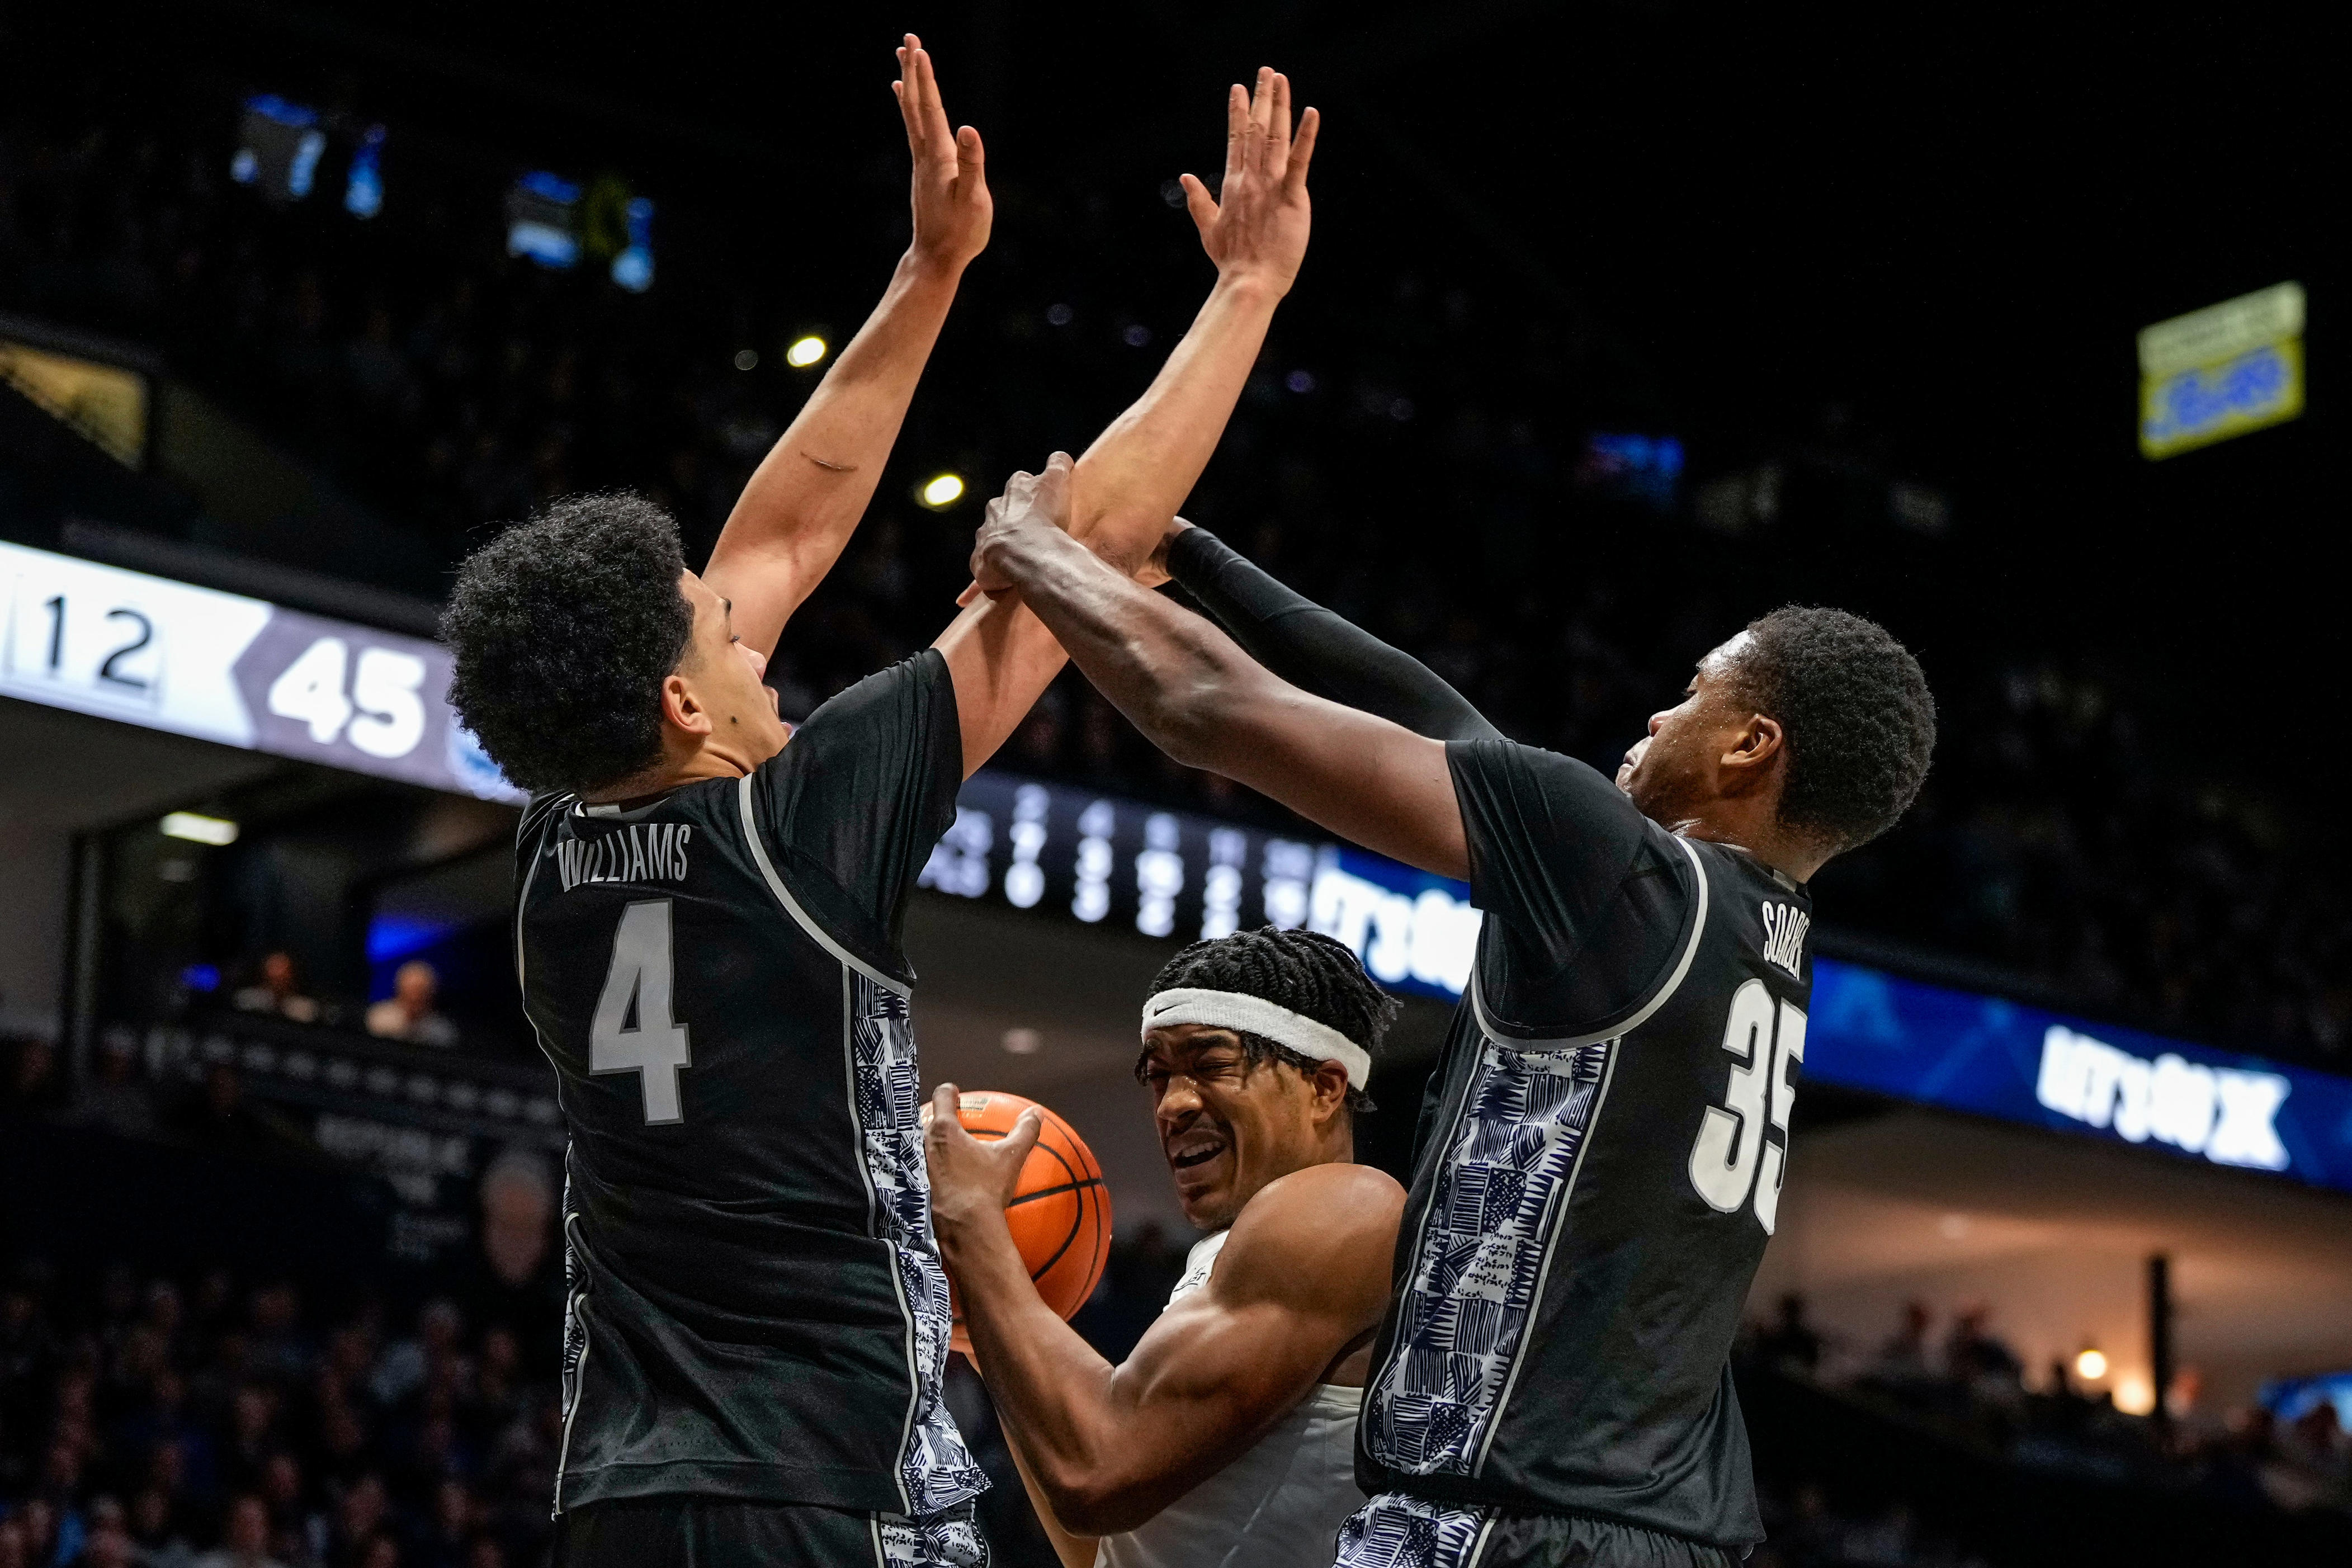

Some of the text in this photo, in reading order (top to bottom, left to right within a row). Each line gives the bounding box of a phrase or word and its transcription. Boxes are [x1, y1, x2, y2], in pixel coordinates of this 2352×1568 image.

[44, 593, 153, 689] 12
[268, 637, 426, 759] 45
[559, 823, 691, 892] WILLIAMS
[588, 898, 692, 1126] 4
[1688, 977, 1808, 1236] 35
